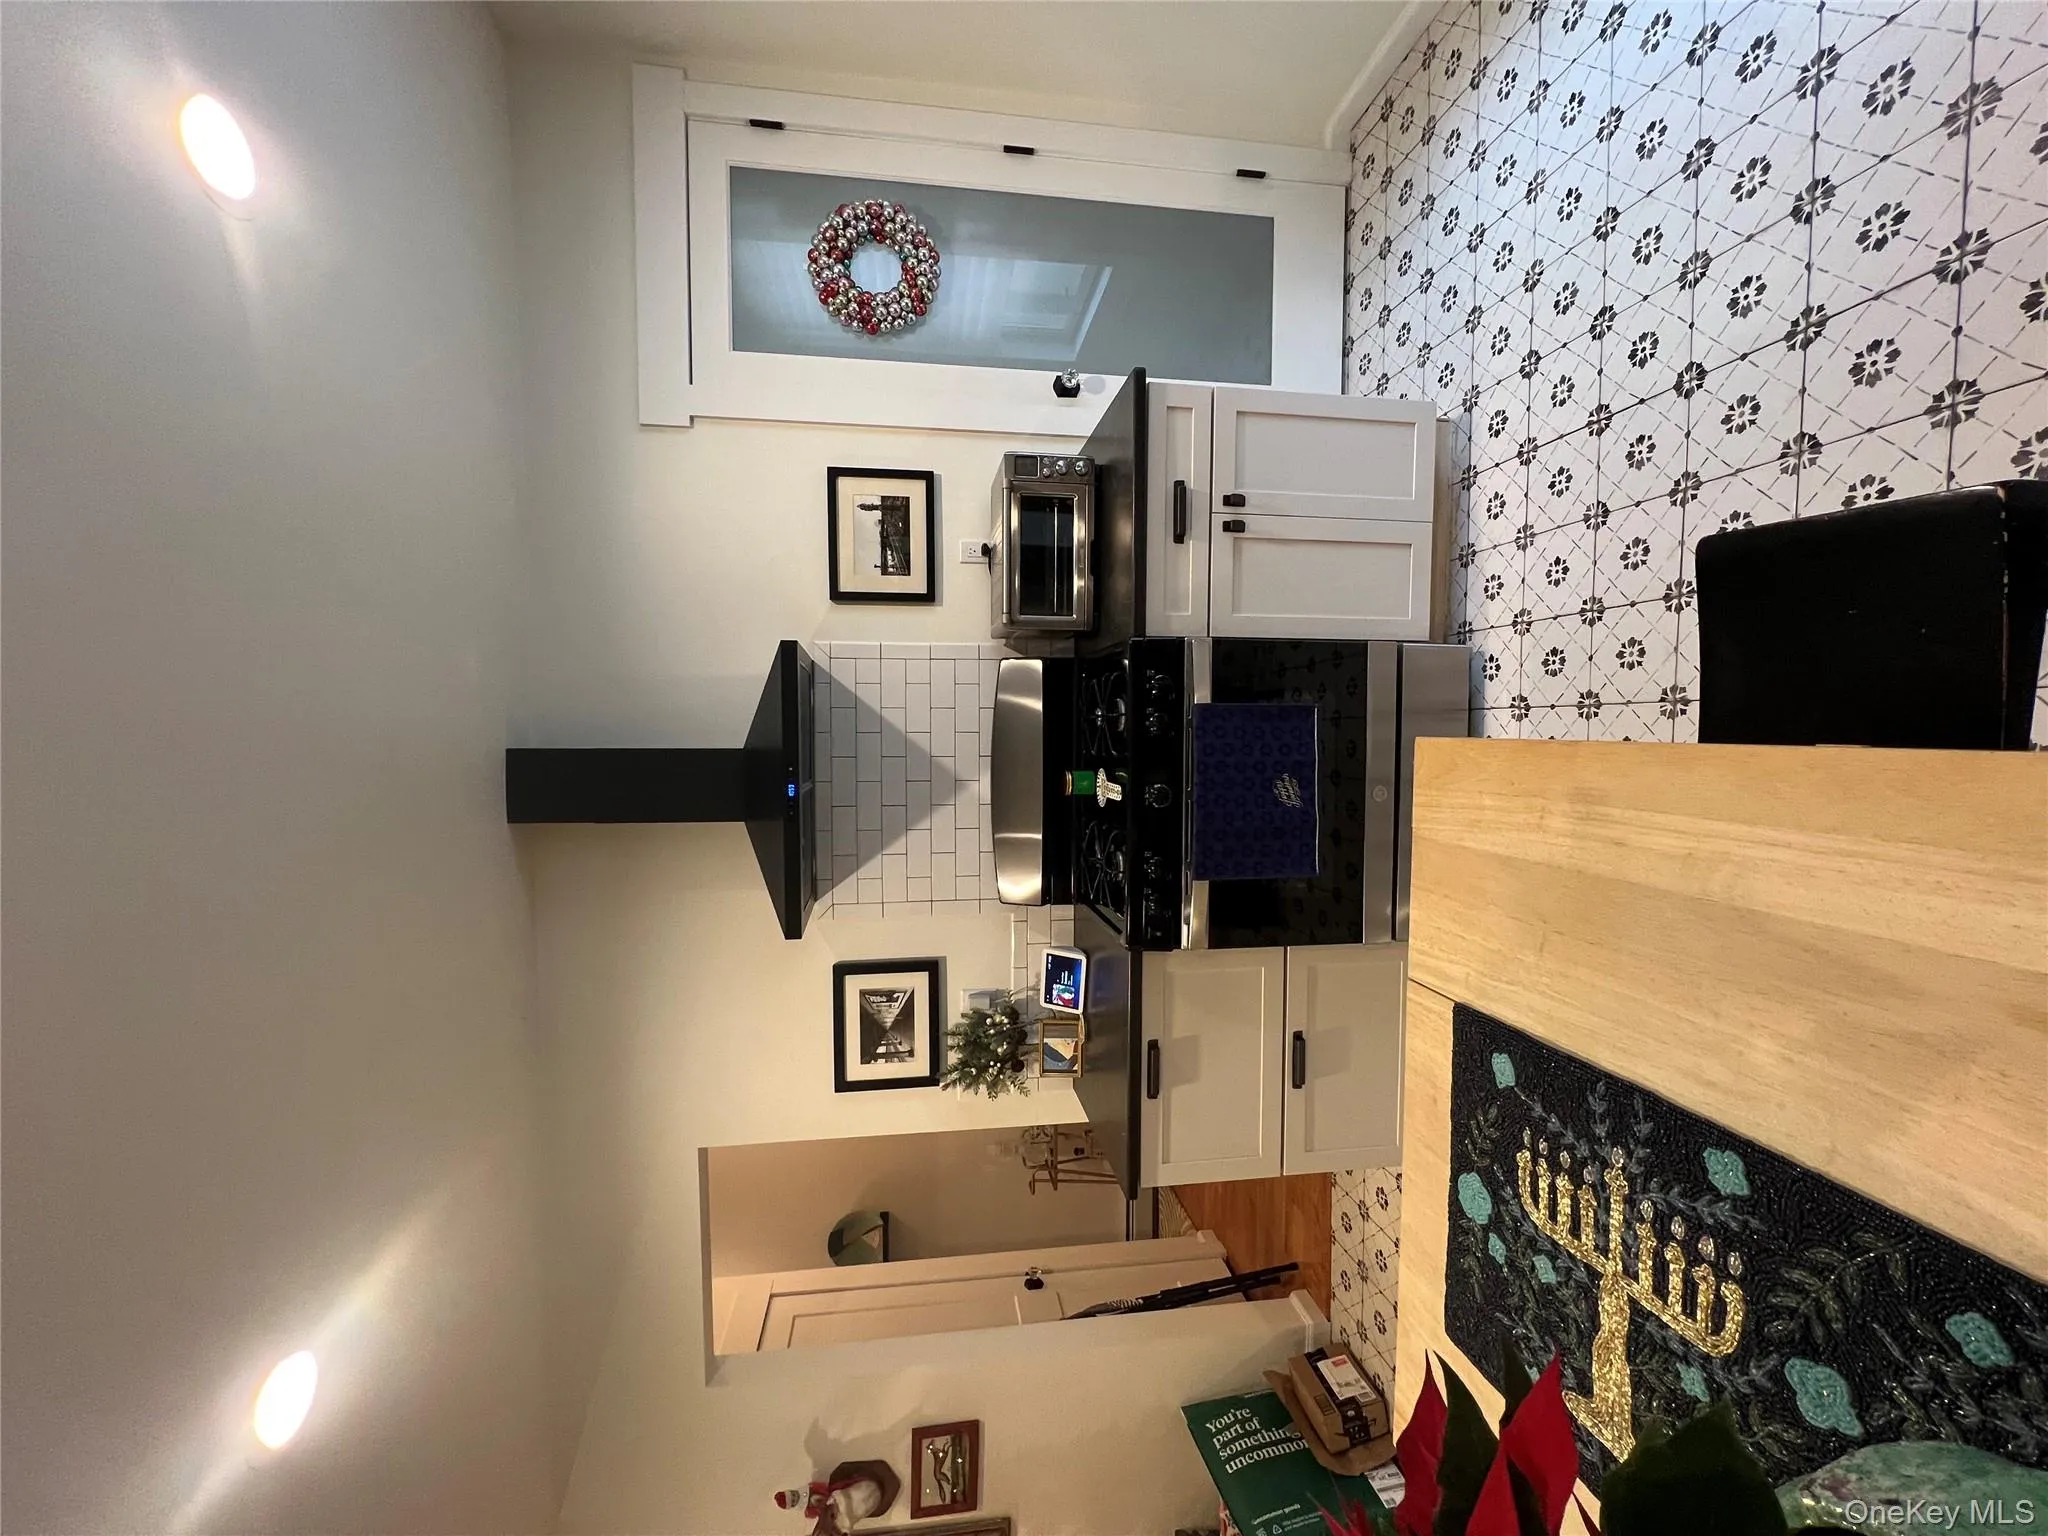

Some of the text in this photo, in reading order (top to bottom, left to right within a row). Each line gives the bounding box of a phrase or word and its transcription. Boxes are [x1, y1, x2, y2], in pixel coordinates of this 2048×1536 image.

[1205, 1407, 1252, 1433] You're
[1212, 1416, 1261, 1449] part of
